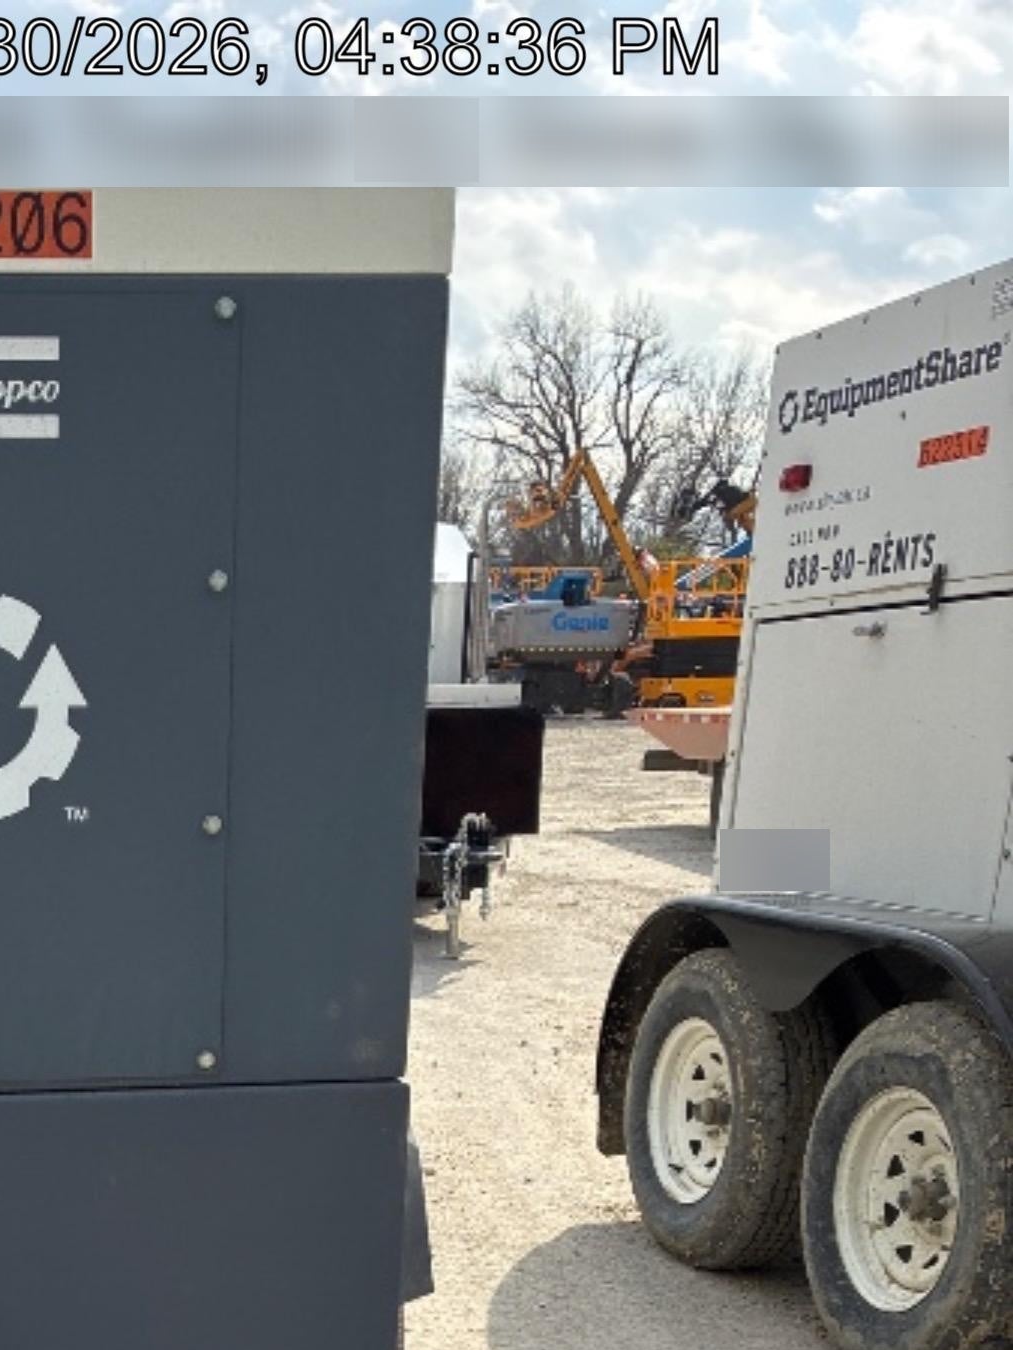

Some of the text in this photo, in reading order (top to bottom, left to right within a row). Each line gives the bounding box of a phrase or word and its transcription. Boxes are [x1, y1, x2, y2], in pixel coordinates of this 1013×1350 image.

[802, 341, 1002, 425] EquipmentShare
[785, 533, 936, 589] 888-80-RENTS
[552, 611, 609, 631] Genie
